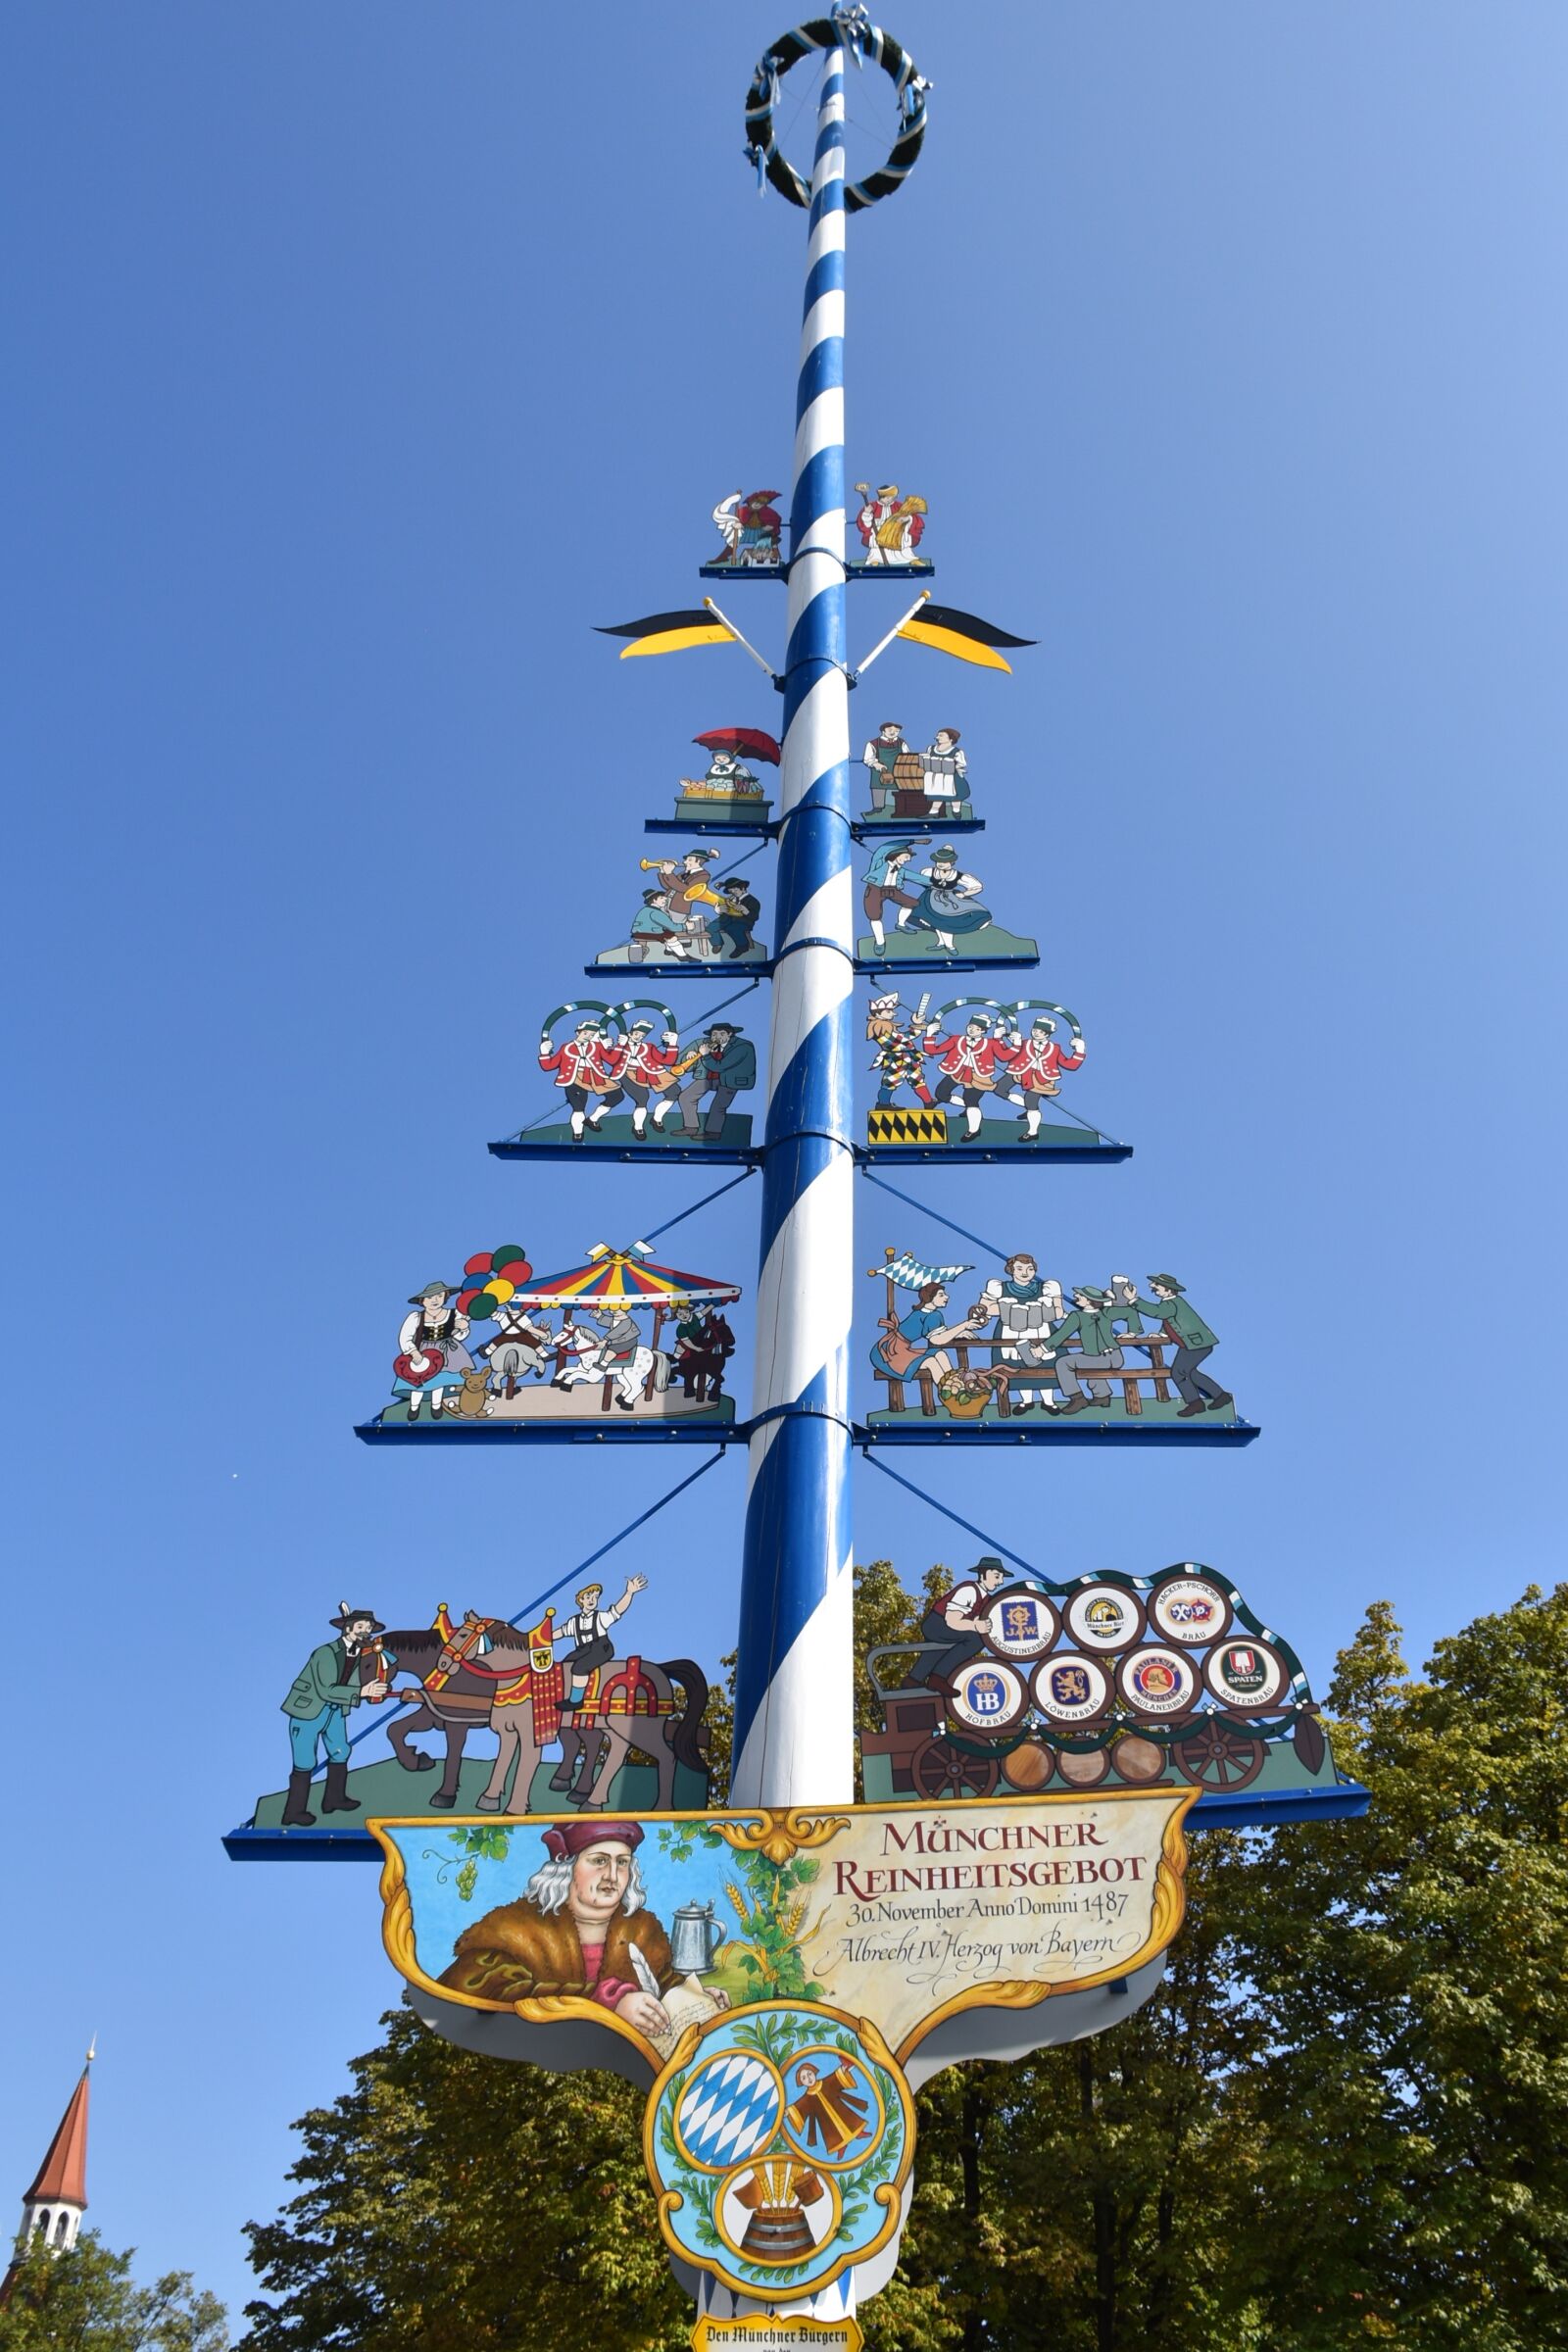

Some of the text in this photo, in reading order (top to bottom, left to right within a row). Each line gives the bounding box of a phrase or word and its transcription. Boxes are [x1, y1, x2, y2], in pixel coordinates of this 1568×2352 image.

[1157, 1582, 1220, 1605] HACKER-PSCHORR
[1228, 1675, 1263, 1684] SPATEN
[975, 1692, 1000, 1711] HB
[832, 1857, 1147, 1902] REINHEITSGEBOT
[967, 1898, 1015, 1918] Anno
[1013, 1892, 1077, 1916] Domini
[1082, 1890, 1129, 1922] 1487
[821, 1927, 920, 1970] Albrecht
[1006, 1941, 1042, 1956] von
[707, 2326, 729, 2342] Den
[733, 2326, 795, 2344] Münchner
